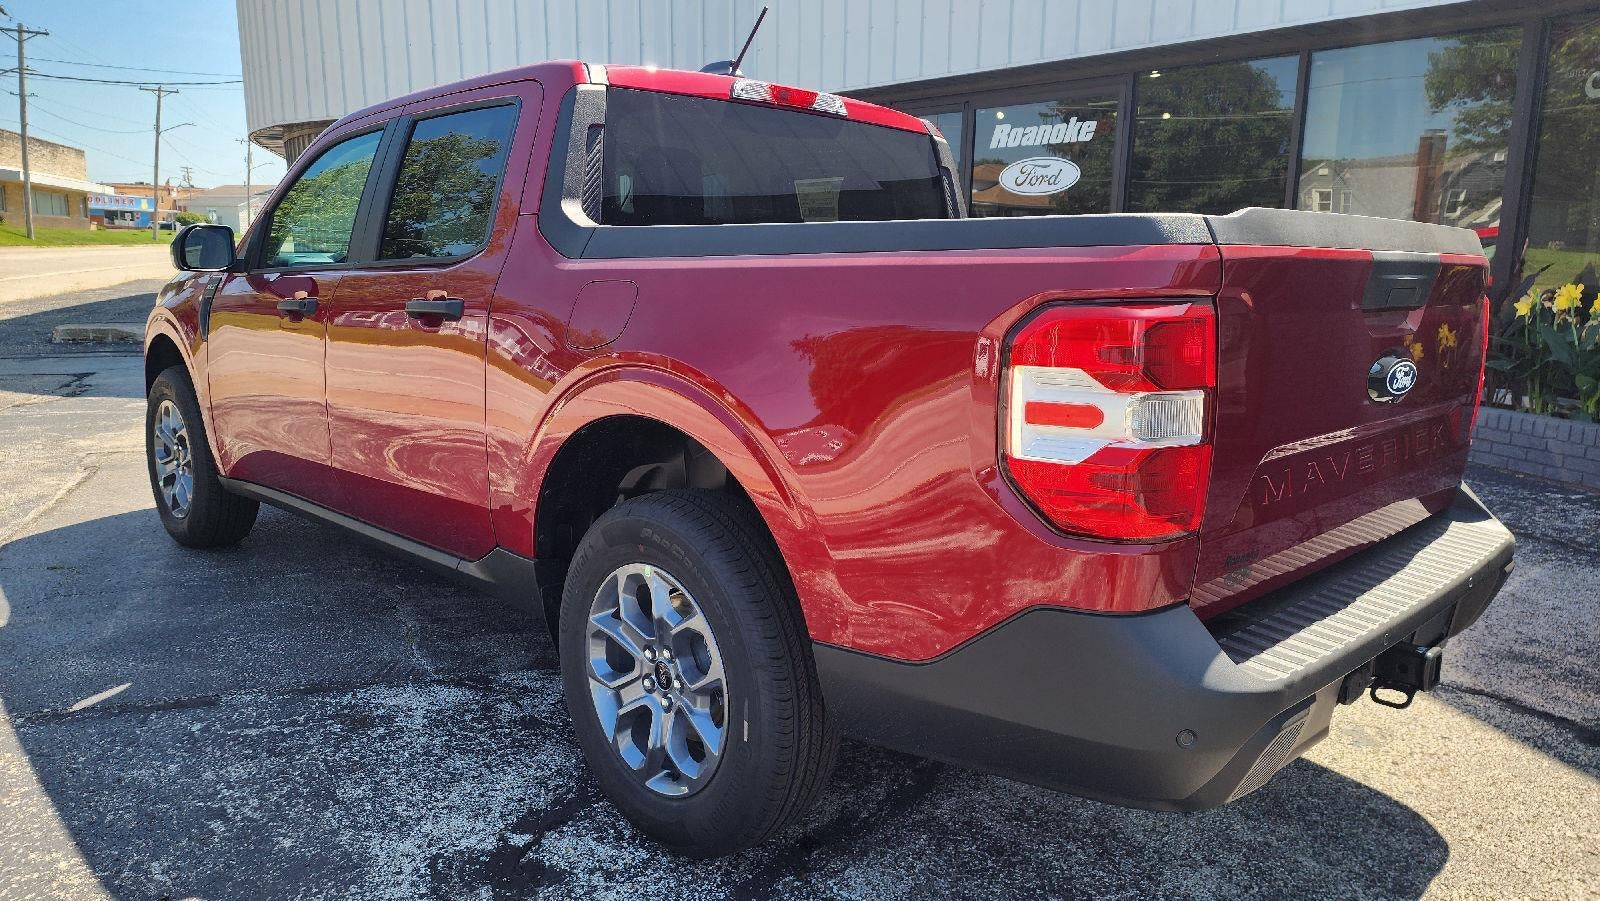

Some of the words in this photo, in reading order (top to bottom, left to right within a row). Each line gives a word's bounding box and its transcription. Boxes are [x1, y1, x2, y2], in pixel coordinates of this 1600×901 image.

[989, 116, 1098, 149] Roanoke
[1015, 163, 1063, 187] Ford
[1260, 423, 1447, 505] MAVERICK
